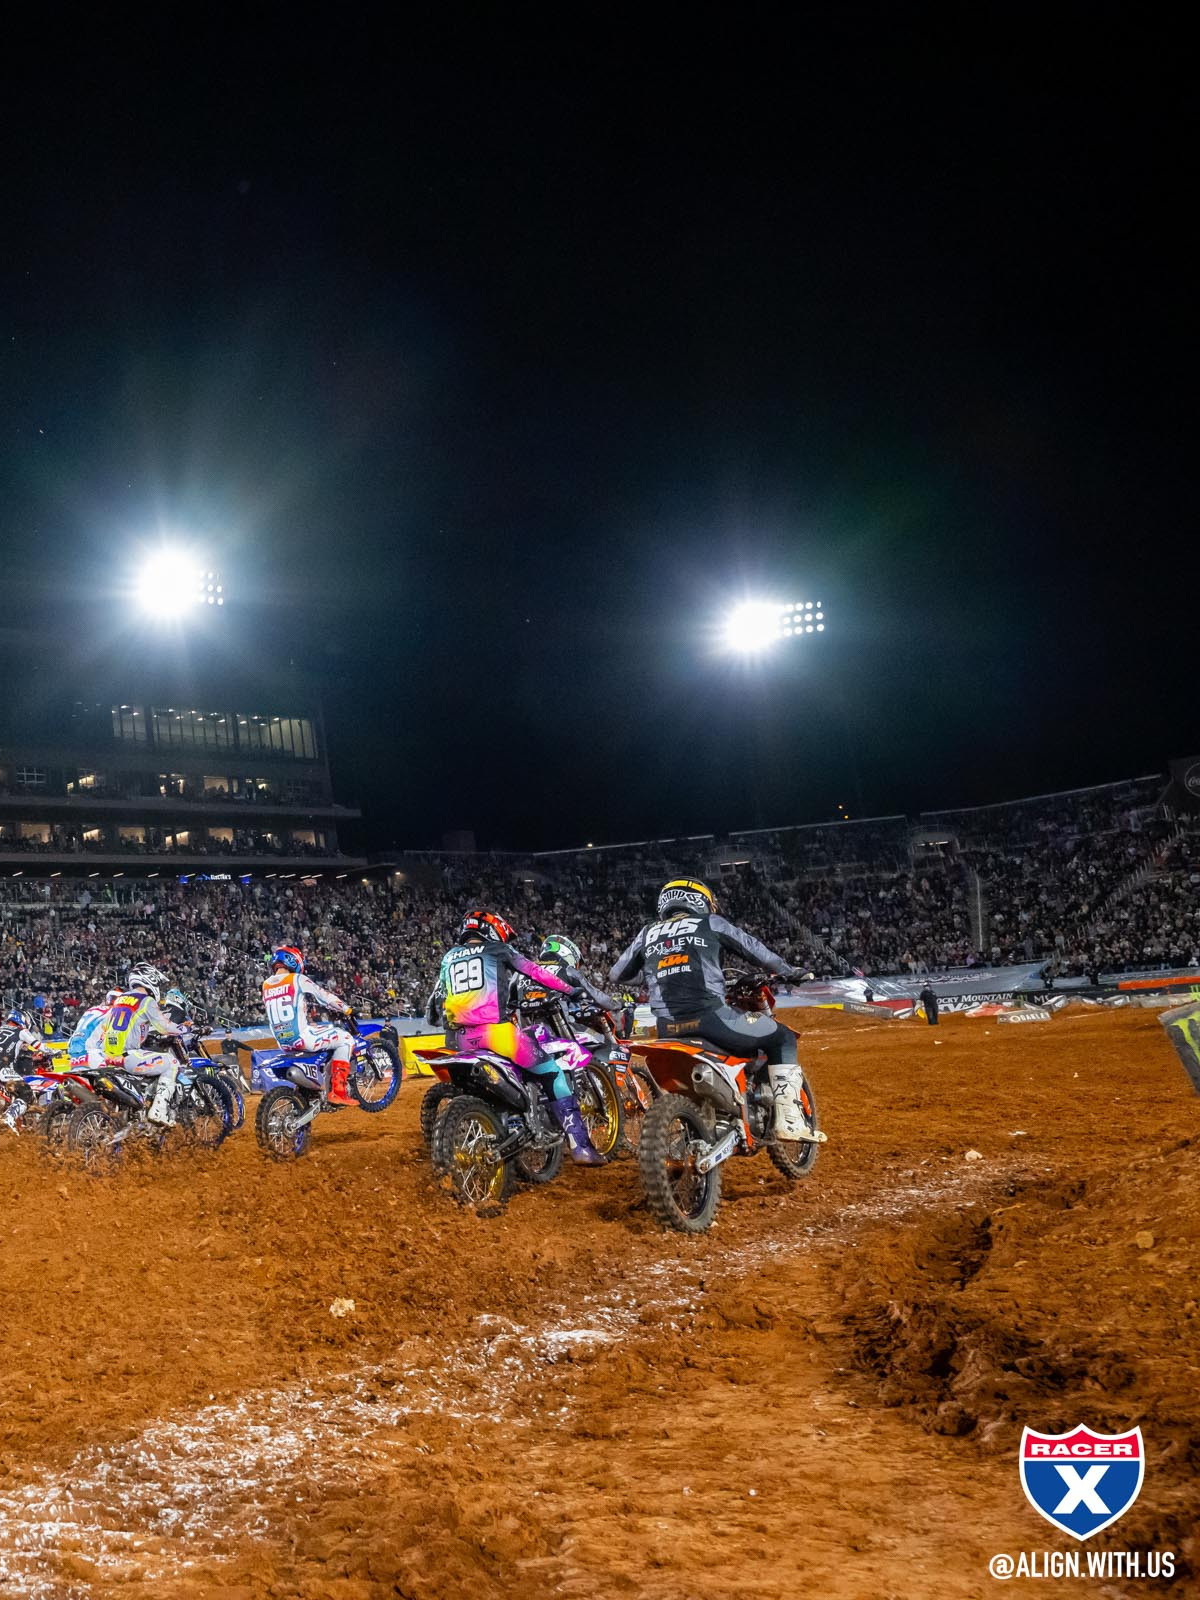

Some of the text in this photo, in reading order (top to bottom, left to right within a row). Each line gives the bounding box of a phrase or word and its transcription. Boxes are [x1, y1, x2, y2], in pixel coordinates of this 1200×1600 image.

[644, 918, 704, 948] 645
[671, 936, 709, 948] LEVEL
[657, 954, 690, 970] KTM
[681, 964, 693, 974] OIL
[449, 957, 485, 996] 129
[936, 992, 1013, 1004] OCKY MOUNTAIN
